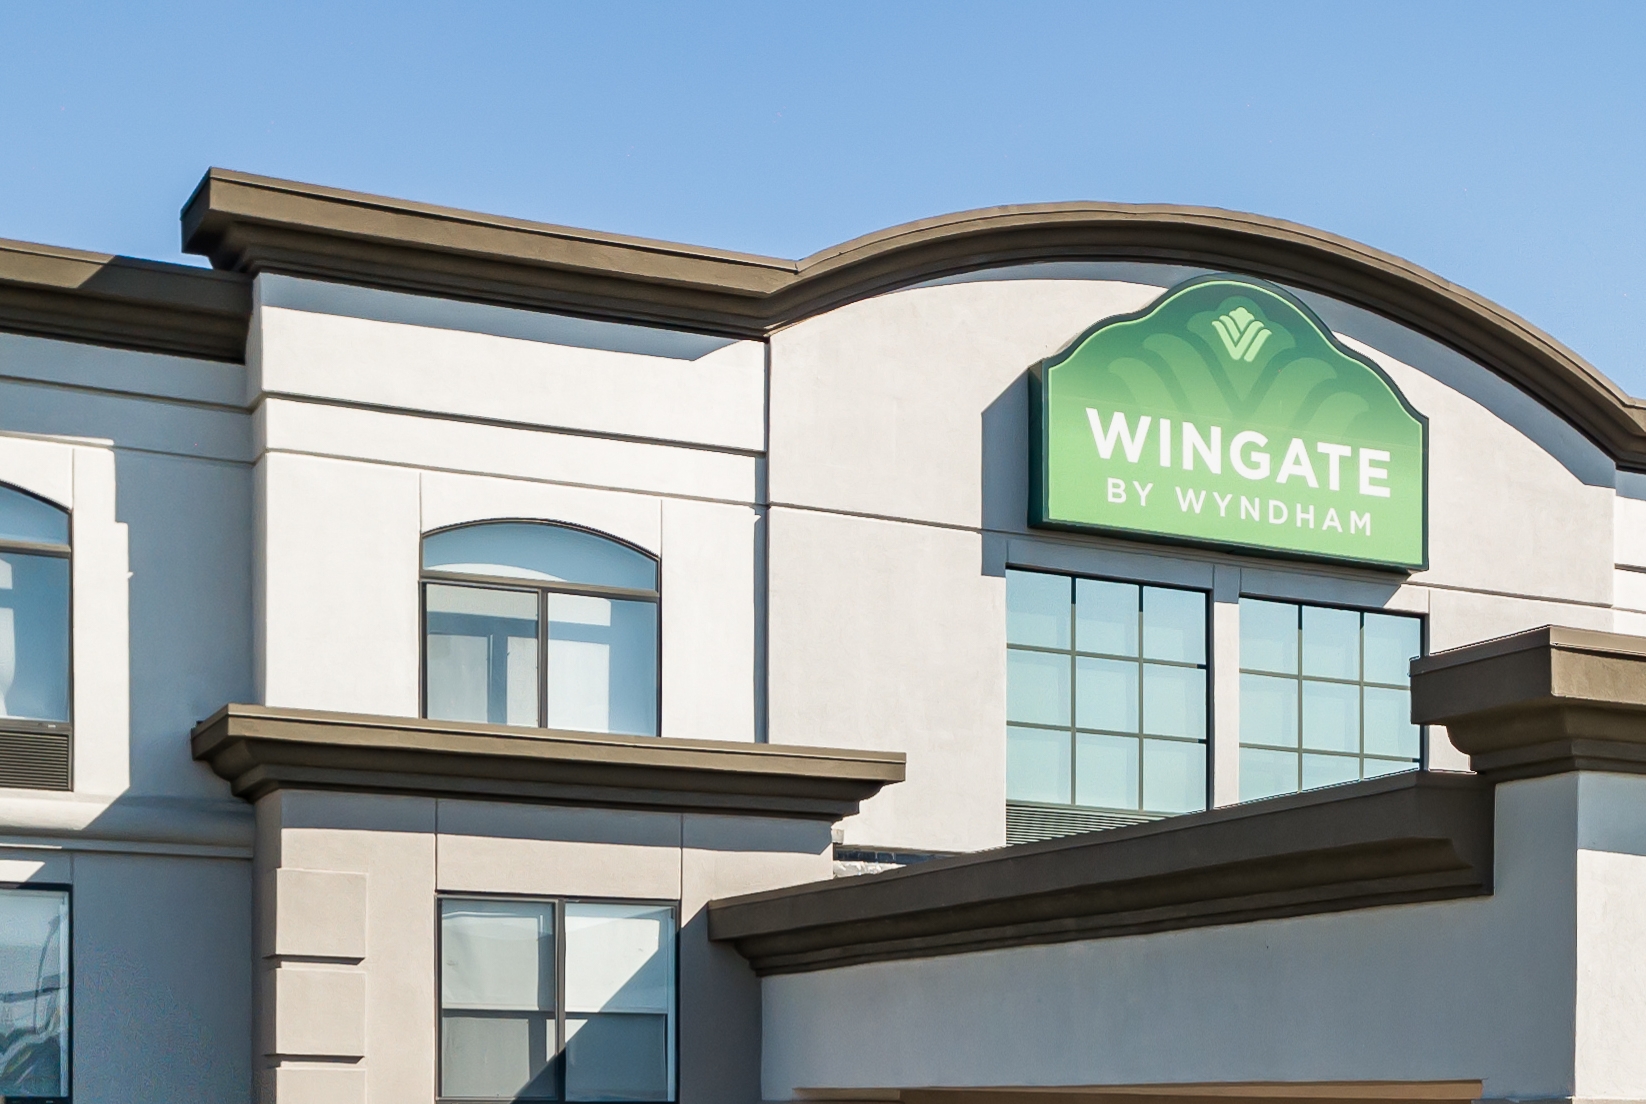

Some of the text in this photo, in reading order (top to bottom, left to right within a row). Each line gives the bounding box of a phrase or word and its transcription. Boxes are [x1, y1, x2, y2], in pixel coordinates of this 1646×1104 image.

[1085, 407, 1392, 499] WINGATE
[1106, 477, 1372, 537] BY WYNDHAM
